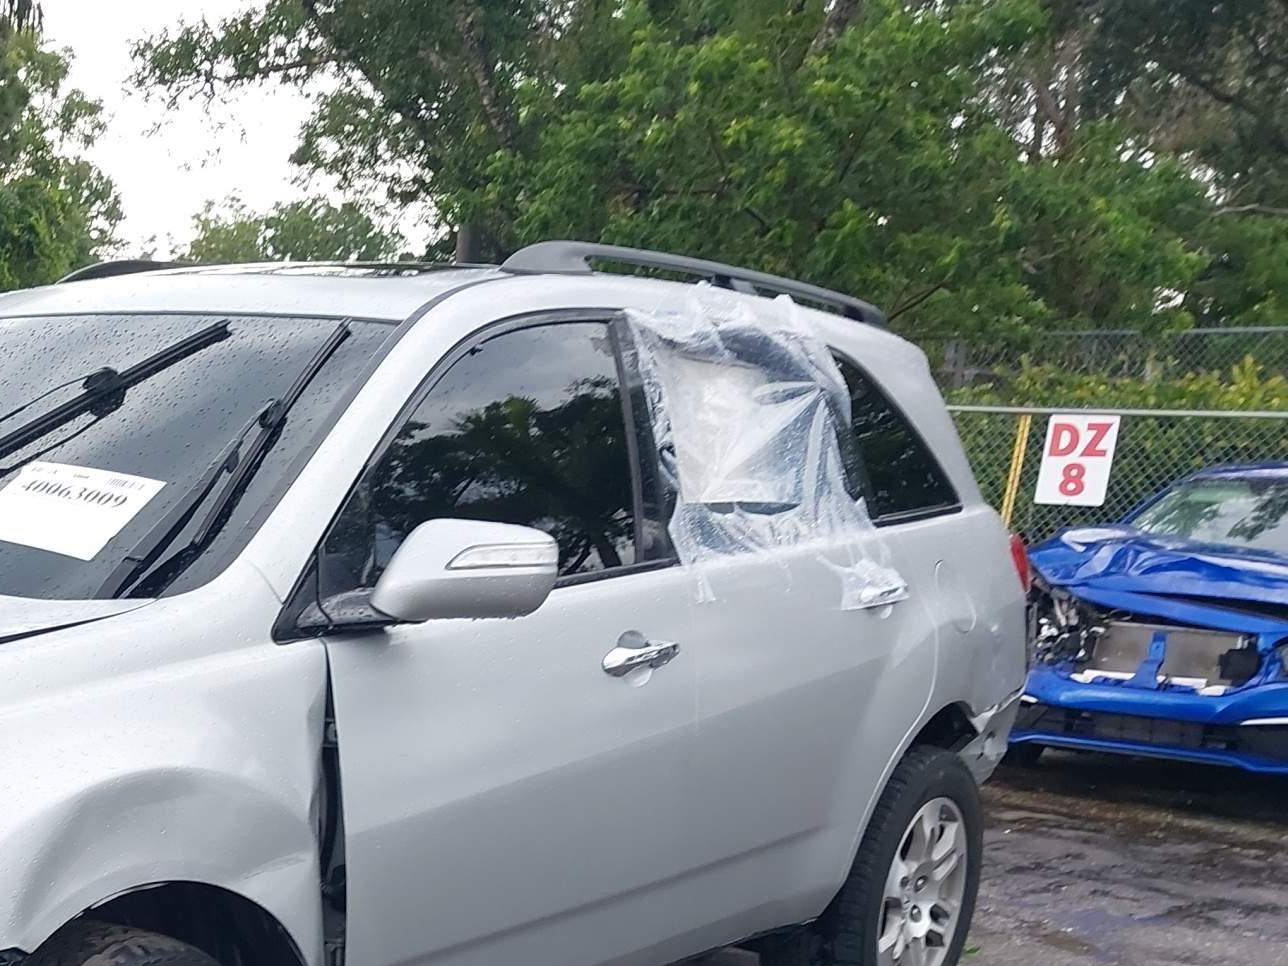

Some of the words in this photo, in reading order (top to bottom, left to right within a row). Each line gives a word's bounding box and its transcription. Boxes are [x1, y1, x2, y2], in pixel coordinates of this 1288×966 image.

[1048, 423, 1114, 457] DZ
[21, 480, 128, 508] 40063009
[1059, 463, 1085, 496] 8
